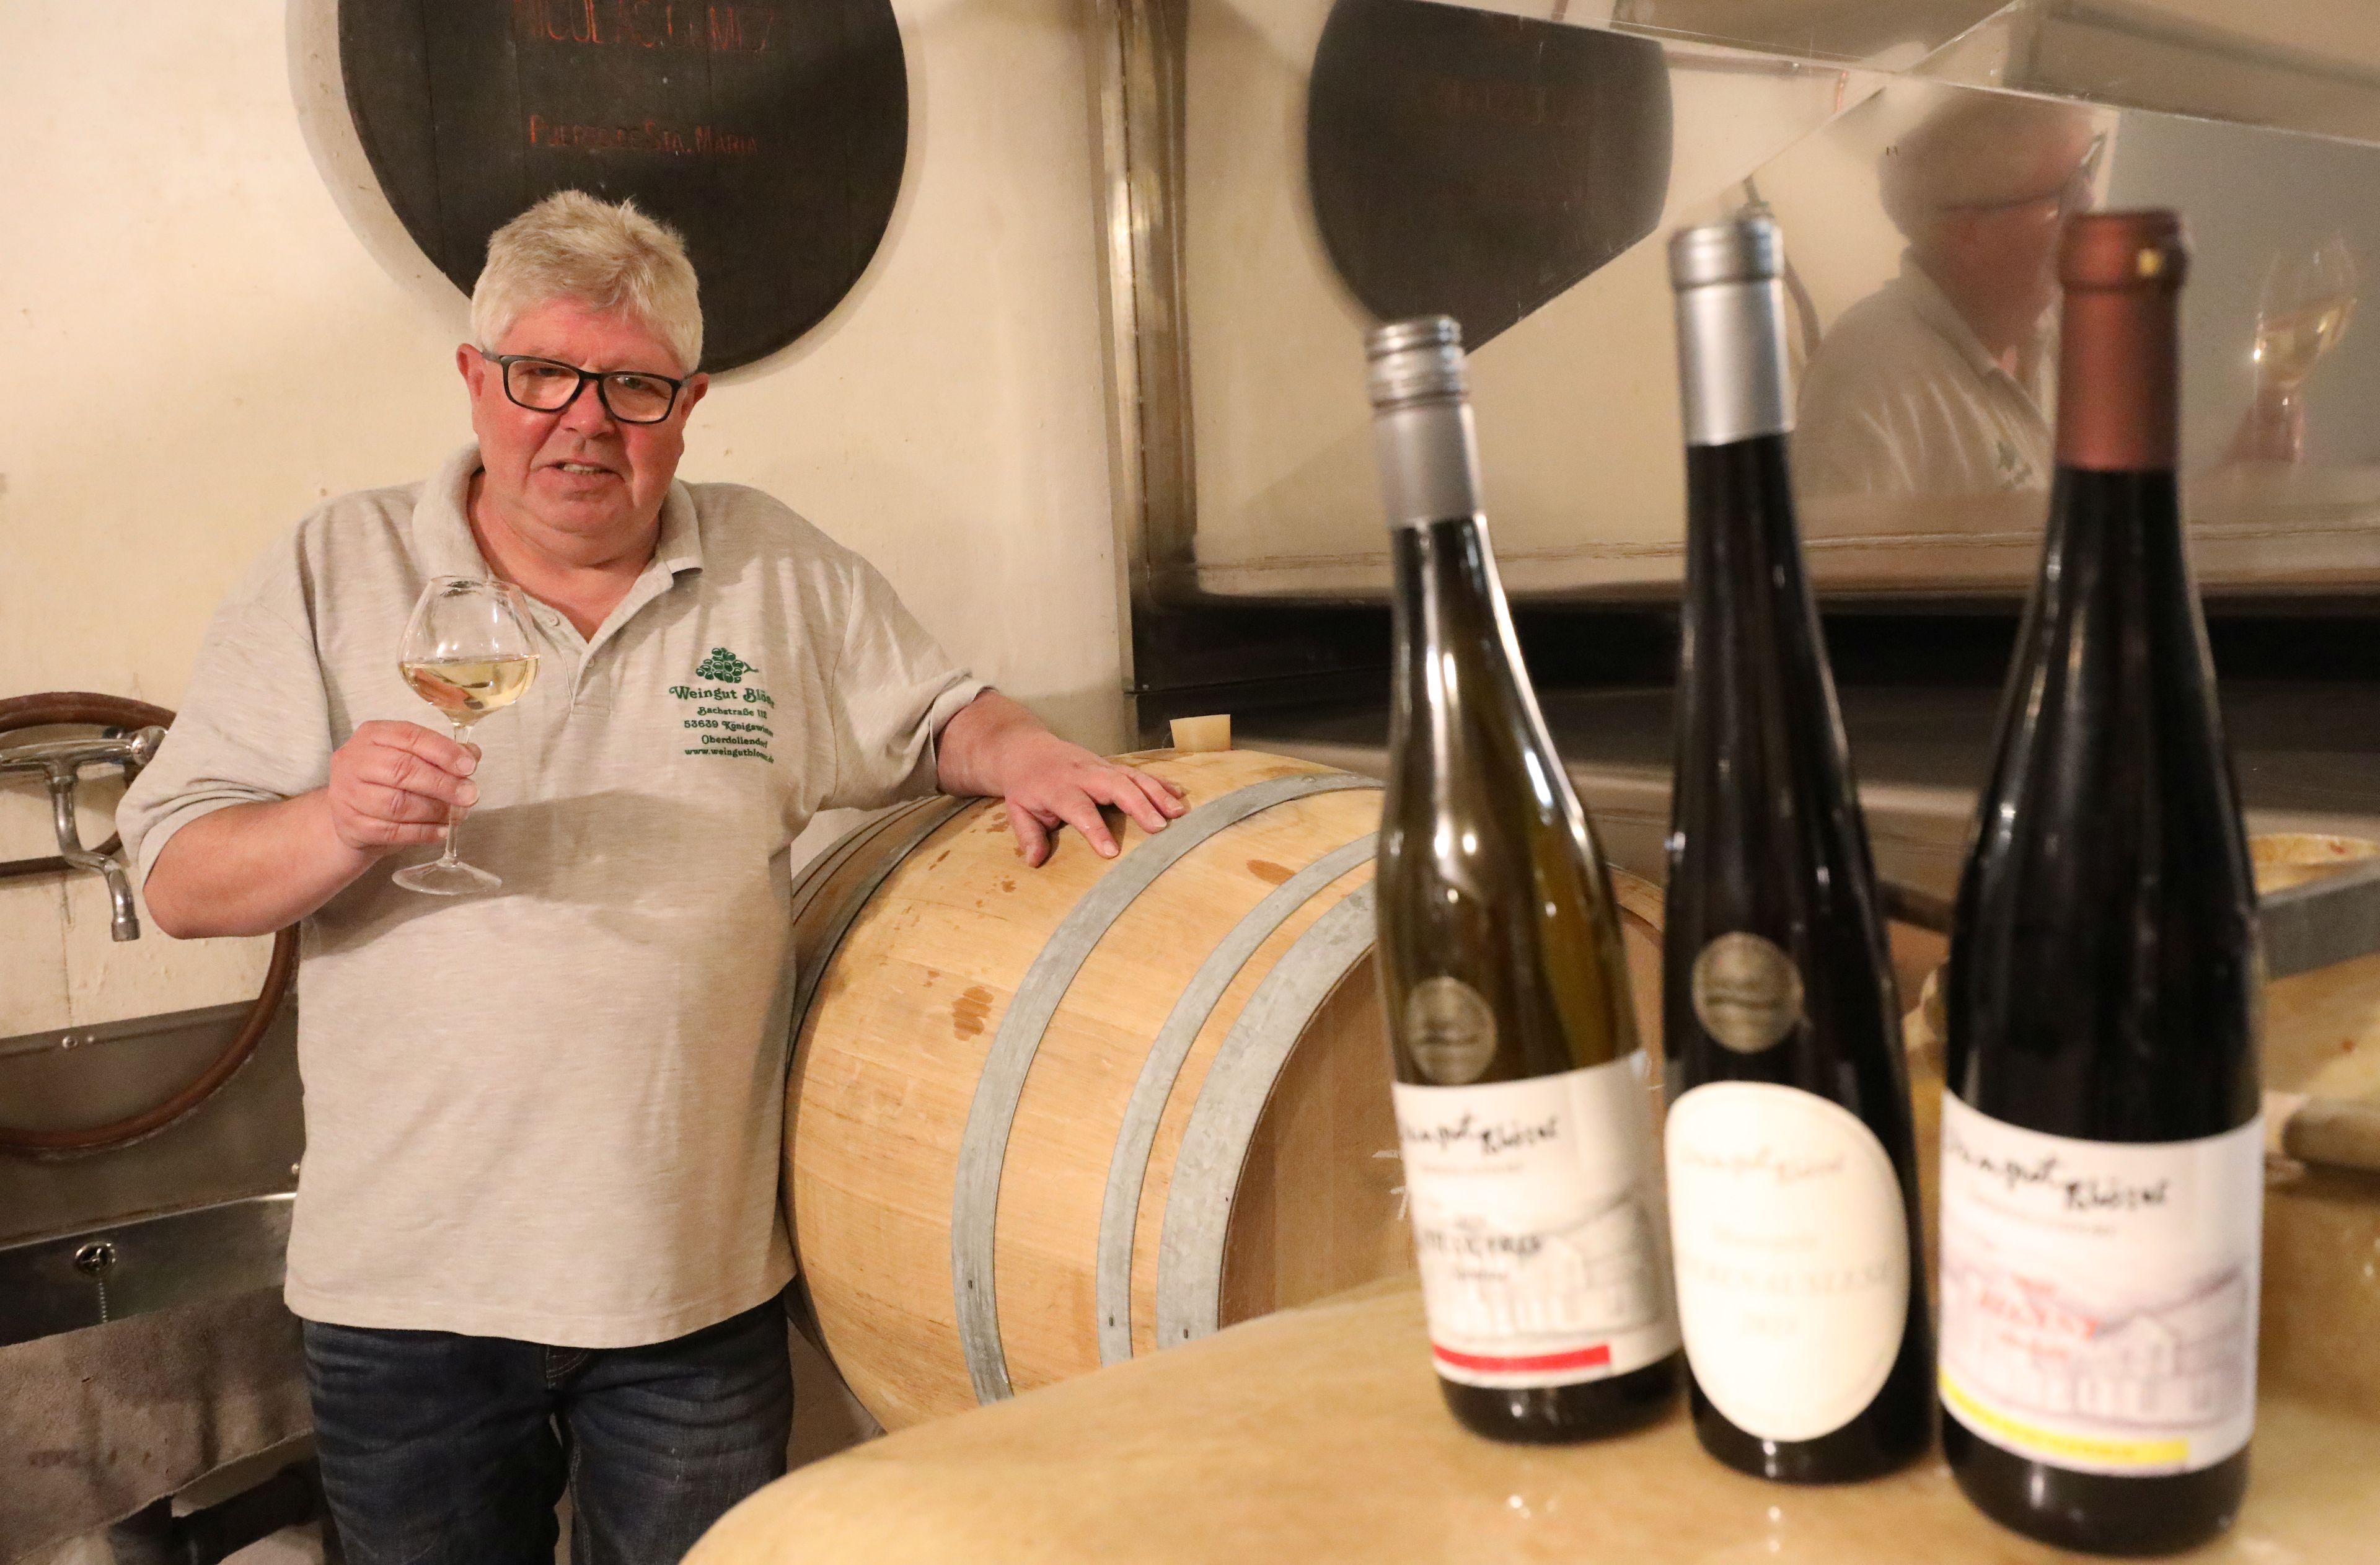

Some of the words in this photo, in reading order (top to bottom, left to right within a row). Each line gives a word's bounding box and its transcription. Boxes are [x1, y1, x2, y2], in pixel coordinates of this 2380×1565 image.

[669, 686, 738, 700] Weingut
[697, 707, 754, 716] Bachstraße
[684, 720, 718, 728] 53639
